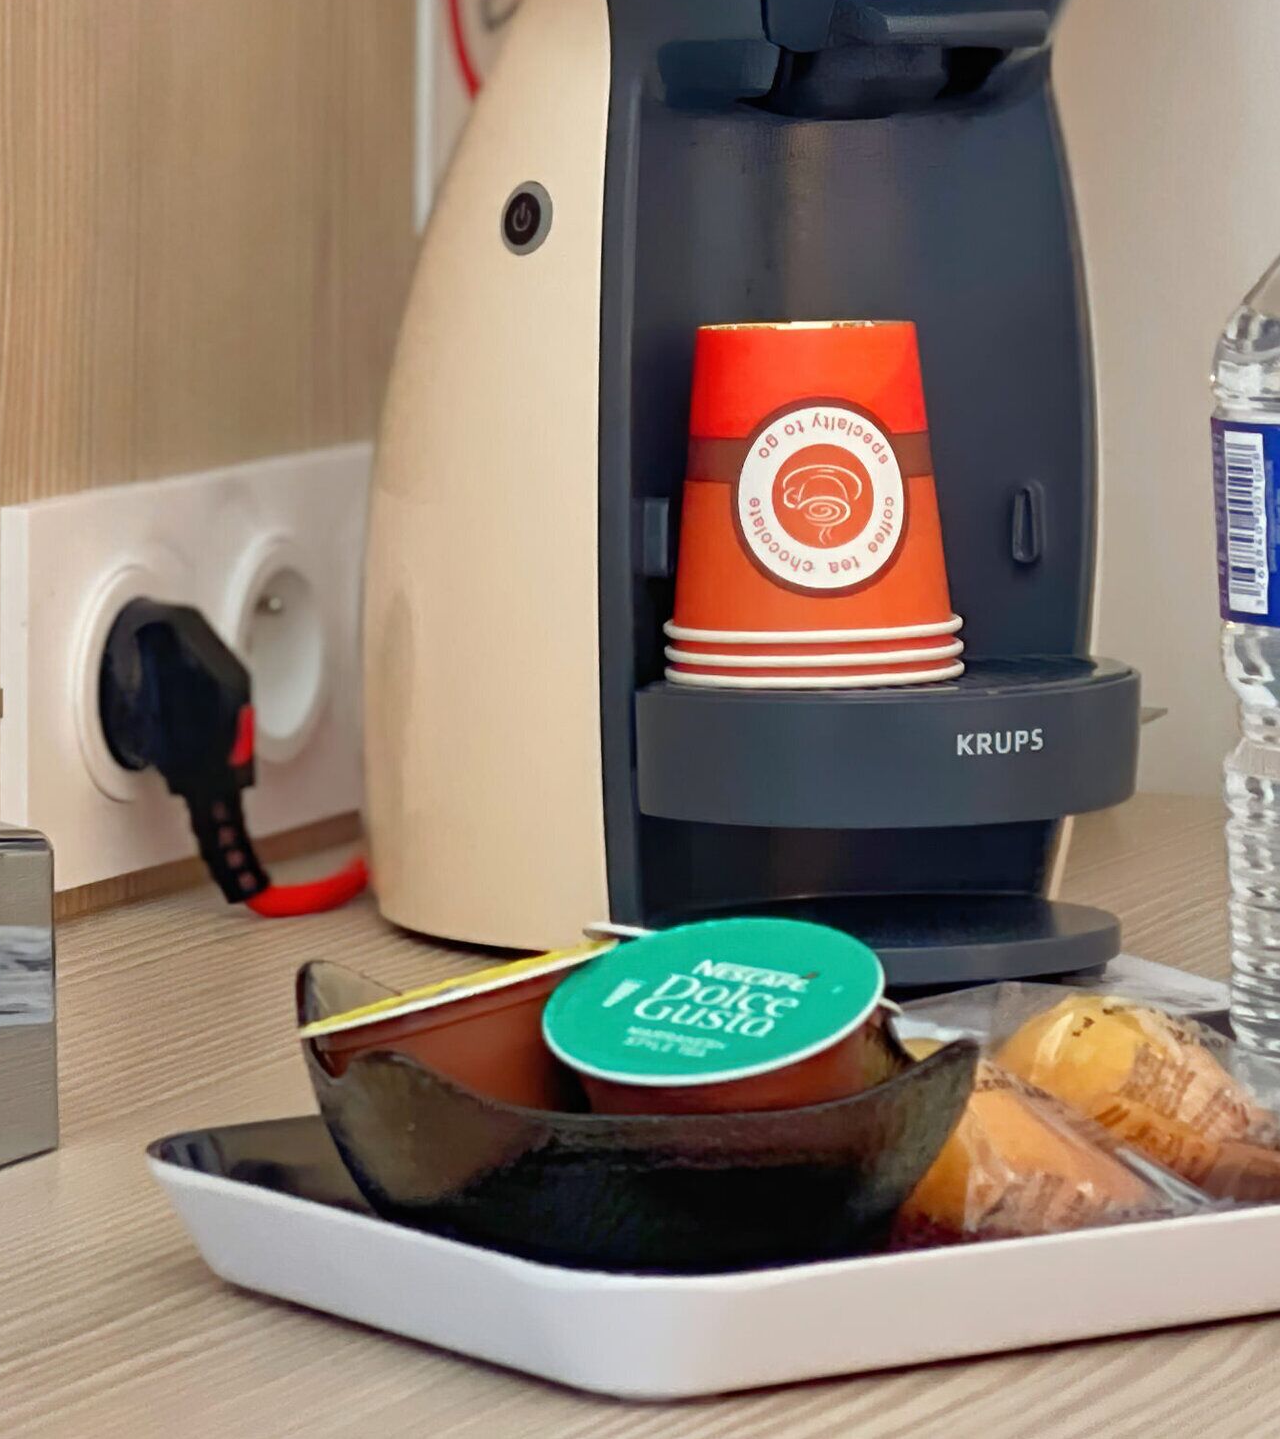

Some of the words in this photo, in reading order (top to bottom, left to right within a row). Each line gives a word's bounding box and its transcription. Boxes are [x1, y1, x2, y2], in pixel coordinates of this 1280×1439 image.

[758, 433, 779, 459] go
[783, 420, 804, 436] to
[811, 412, 889, 465] specialty
[748, 497, 814, 575] chocolate
[868, 496, 895, 555] coffee
[828, 555, 861, 574] tea
[956, 728, 1044, 756] KRUPS
[634, 994, 776, 1038] Gusto
[652, 973, 799, 1018] Dolce
